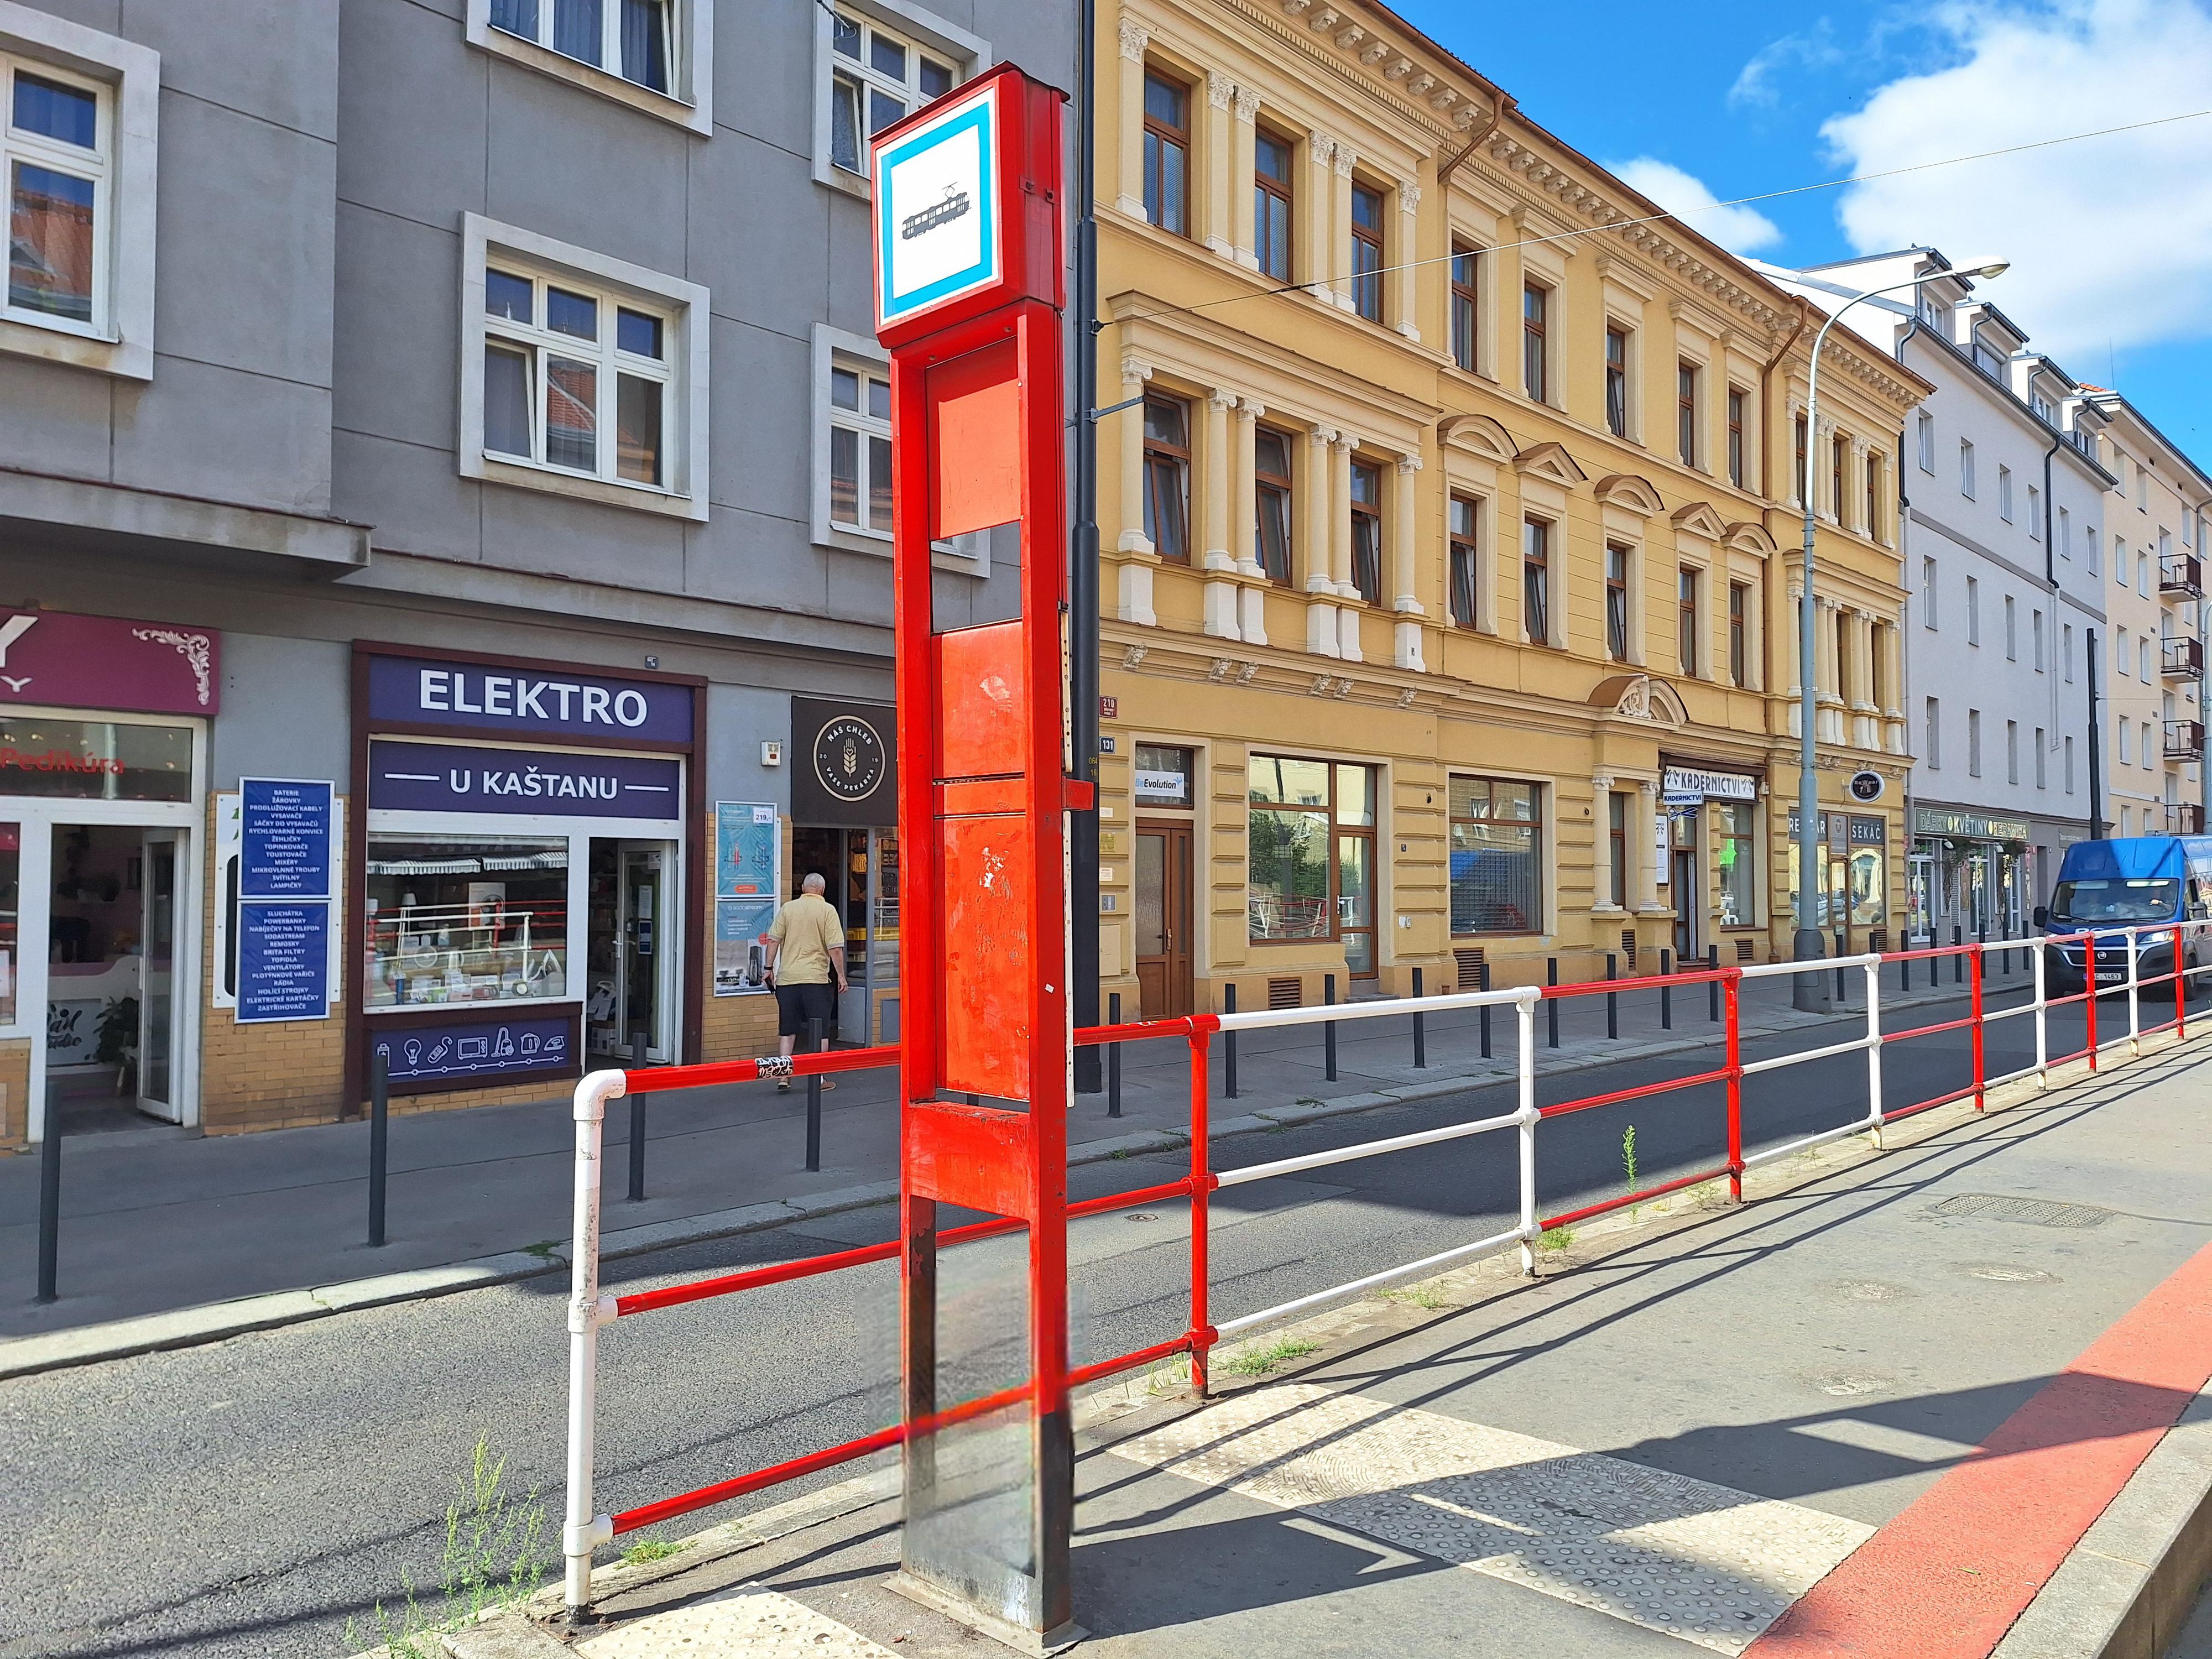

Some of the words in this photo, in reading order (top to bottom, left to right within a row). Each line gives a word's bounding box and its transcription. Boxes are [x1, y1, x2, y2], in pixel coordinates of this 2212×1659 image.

[420, 669, 648, 727] ELEKTRO
[1103, 698, 1114, 708] 210
[1103, 739, 1113, 750] 131
[0, 748, 124, 774] Pedikúra
[450, 769, 471, 794] U
[483, 765, 618, 800] KAŠTANU
[1135, 778, 1176, 789] BeEvolution
[1681, 771, 1740, 794] KADEŘNICTVÍ
[1853, 823, 1881, 840] SEKÁČ
[1954, 815, 1987, 835] KVĚTINY
